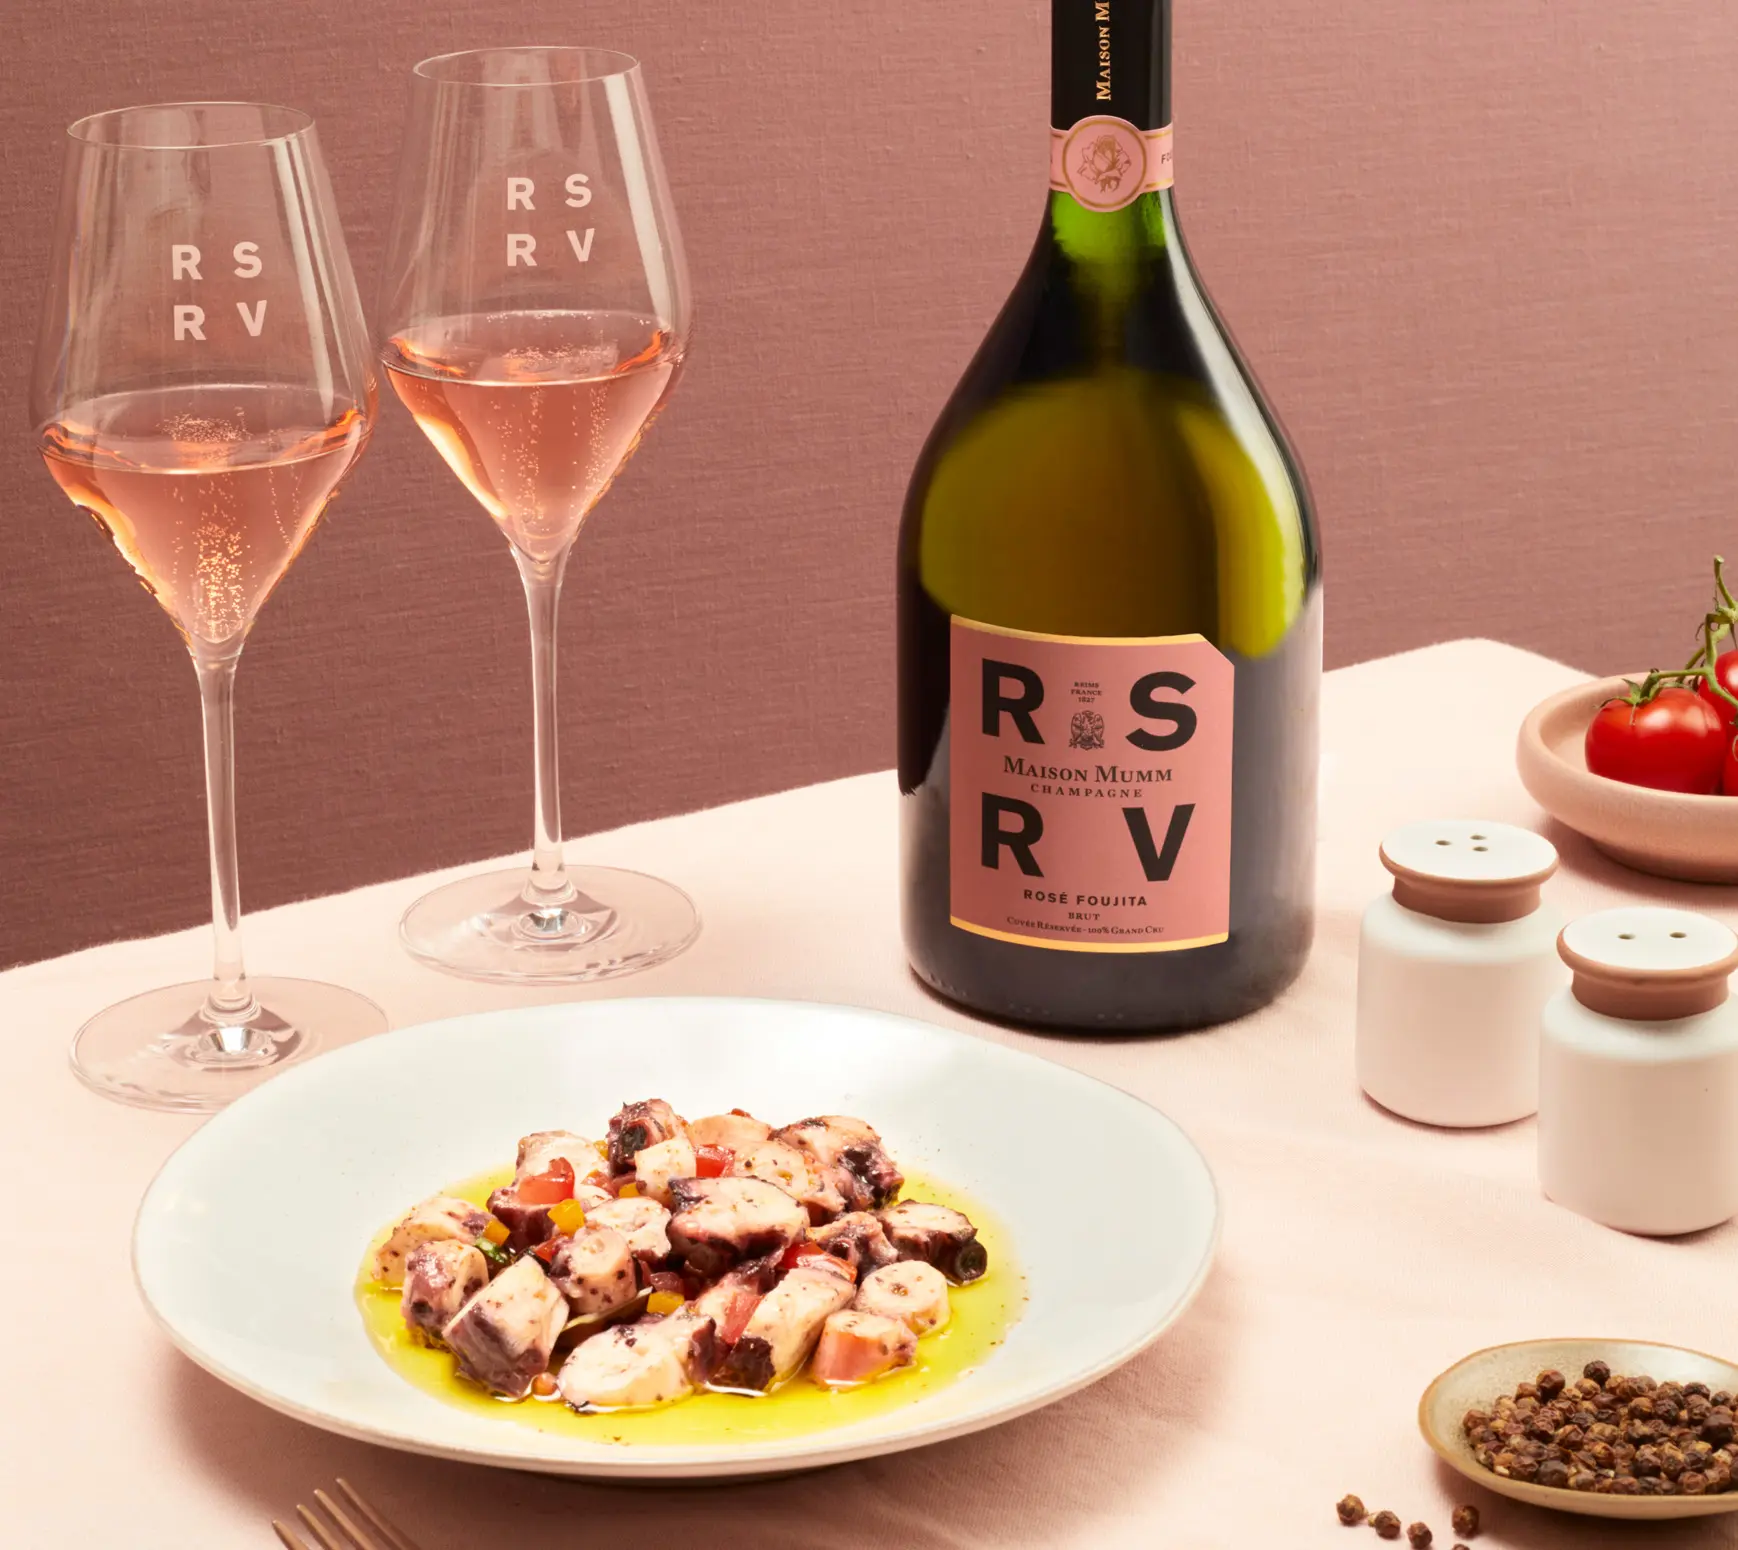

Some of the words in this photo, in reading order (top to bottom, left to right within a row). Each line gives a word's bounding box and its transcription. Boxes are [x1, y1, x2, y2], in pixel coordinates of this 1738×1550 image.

[982, 658, 1045, 745] R
[1125, 671, 1197, 752] S
[1030, 783, 1143, 799] CHAMPAGNE
[981, 792, 1044, 878] R
[1122, 803, 1196, 882] V
[1023, 889, 1068, 905] ROSÉ
[1076, 895, 1148, 907] FOUJITA
[1067, 912, 1100, 921] BRUT
